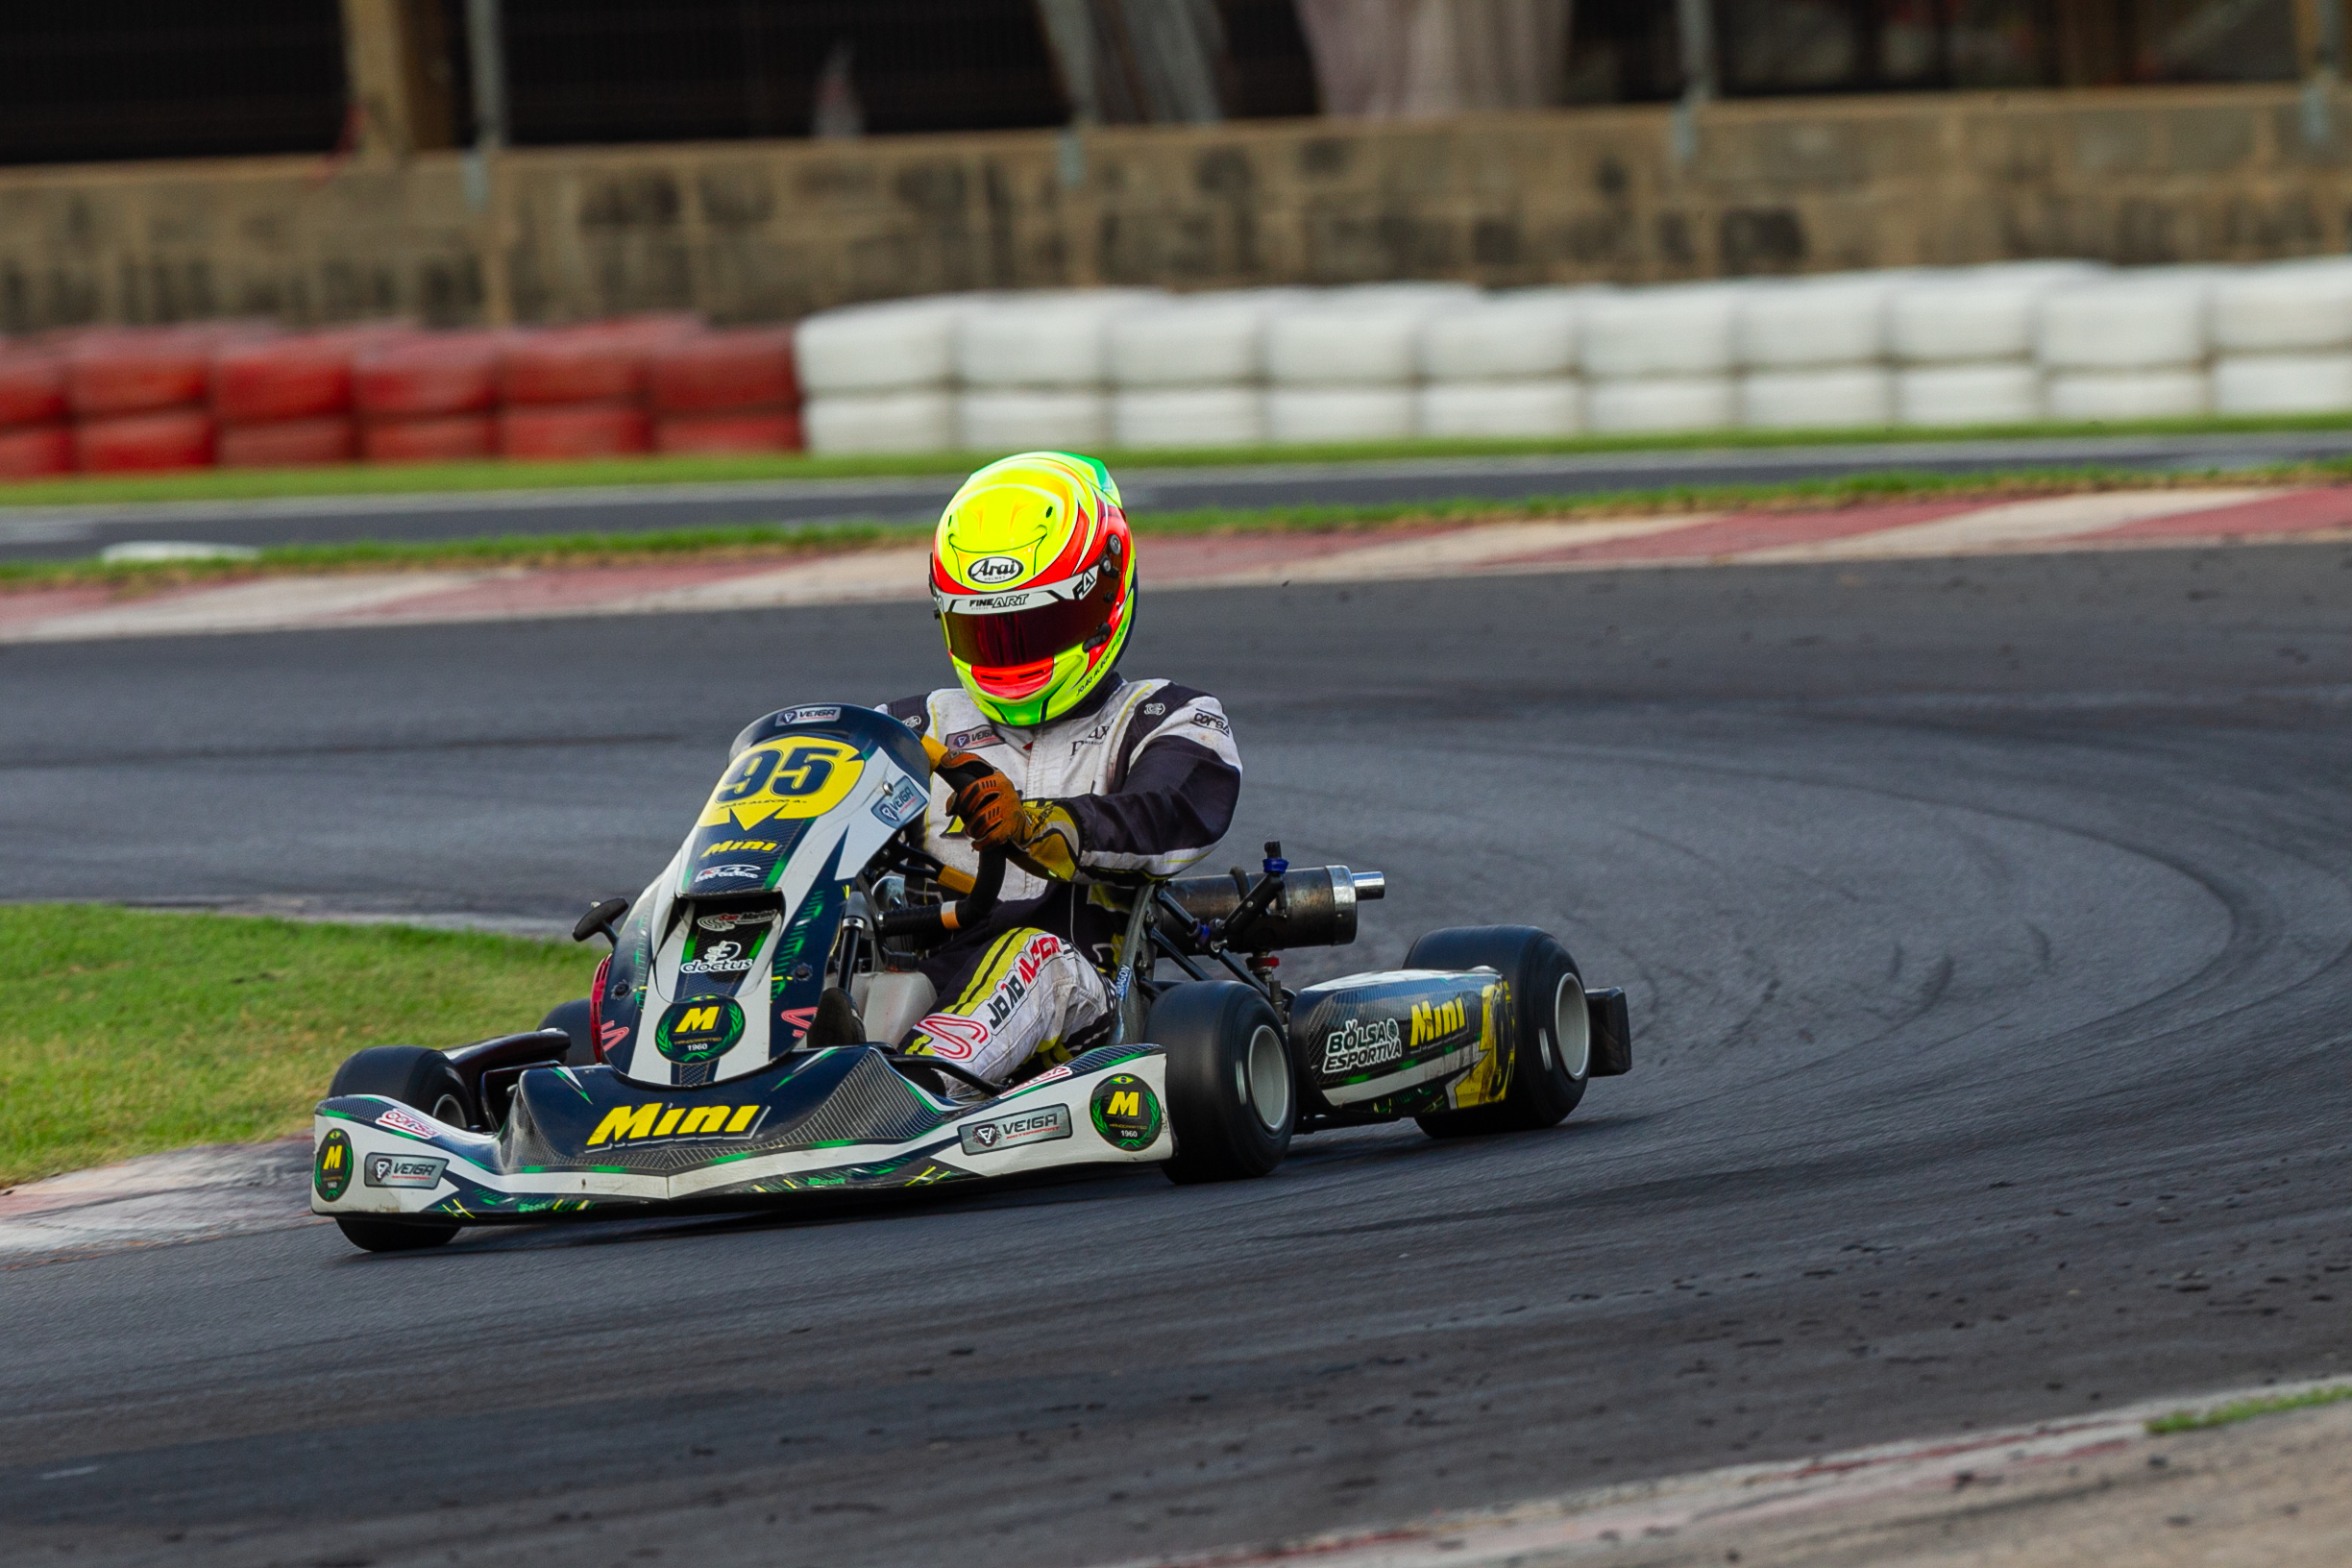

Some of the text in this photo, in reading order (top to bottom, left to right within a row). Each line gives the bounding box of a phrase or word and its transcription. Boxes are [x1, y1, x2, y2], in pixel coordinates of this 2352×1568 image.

[971, 559, 1016, 576] Arai
[799, 709, 837, 718] VEIGA
[715, 747, 842, 803] 95
[890, 786, 915, 811] VEIGA
[700, 840, 777, 858] Mini
[681, 959, 753, 973] doctus
[674, 1006, 720, 1033] M
[1409, 997, 1466, 1046] Mini
[1327, 1019, 1386, 1055] BOLSA
[1323, 1040, 1402, 1072] ESPORTIVA
[1107, 1090, 1139, 1116] M
[586, 1102, 760, 1146] Mini
[1002, 1114, 1058, 1134] VEIGA
[1006, 1126, 1061, 1139] MOTORSPORT
[323, 1145, 342, 1170] M
[392, 1163, 436, 1175] VEIGA
